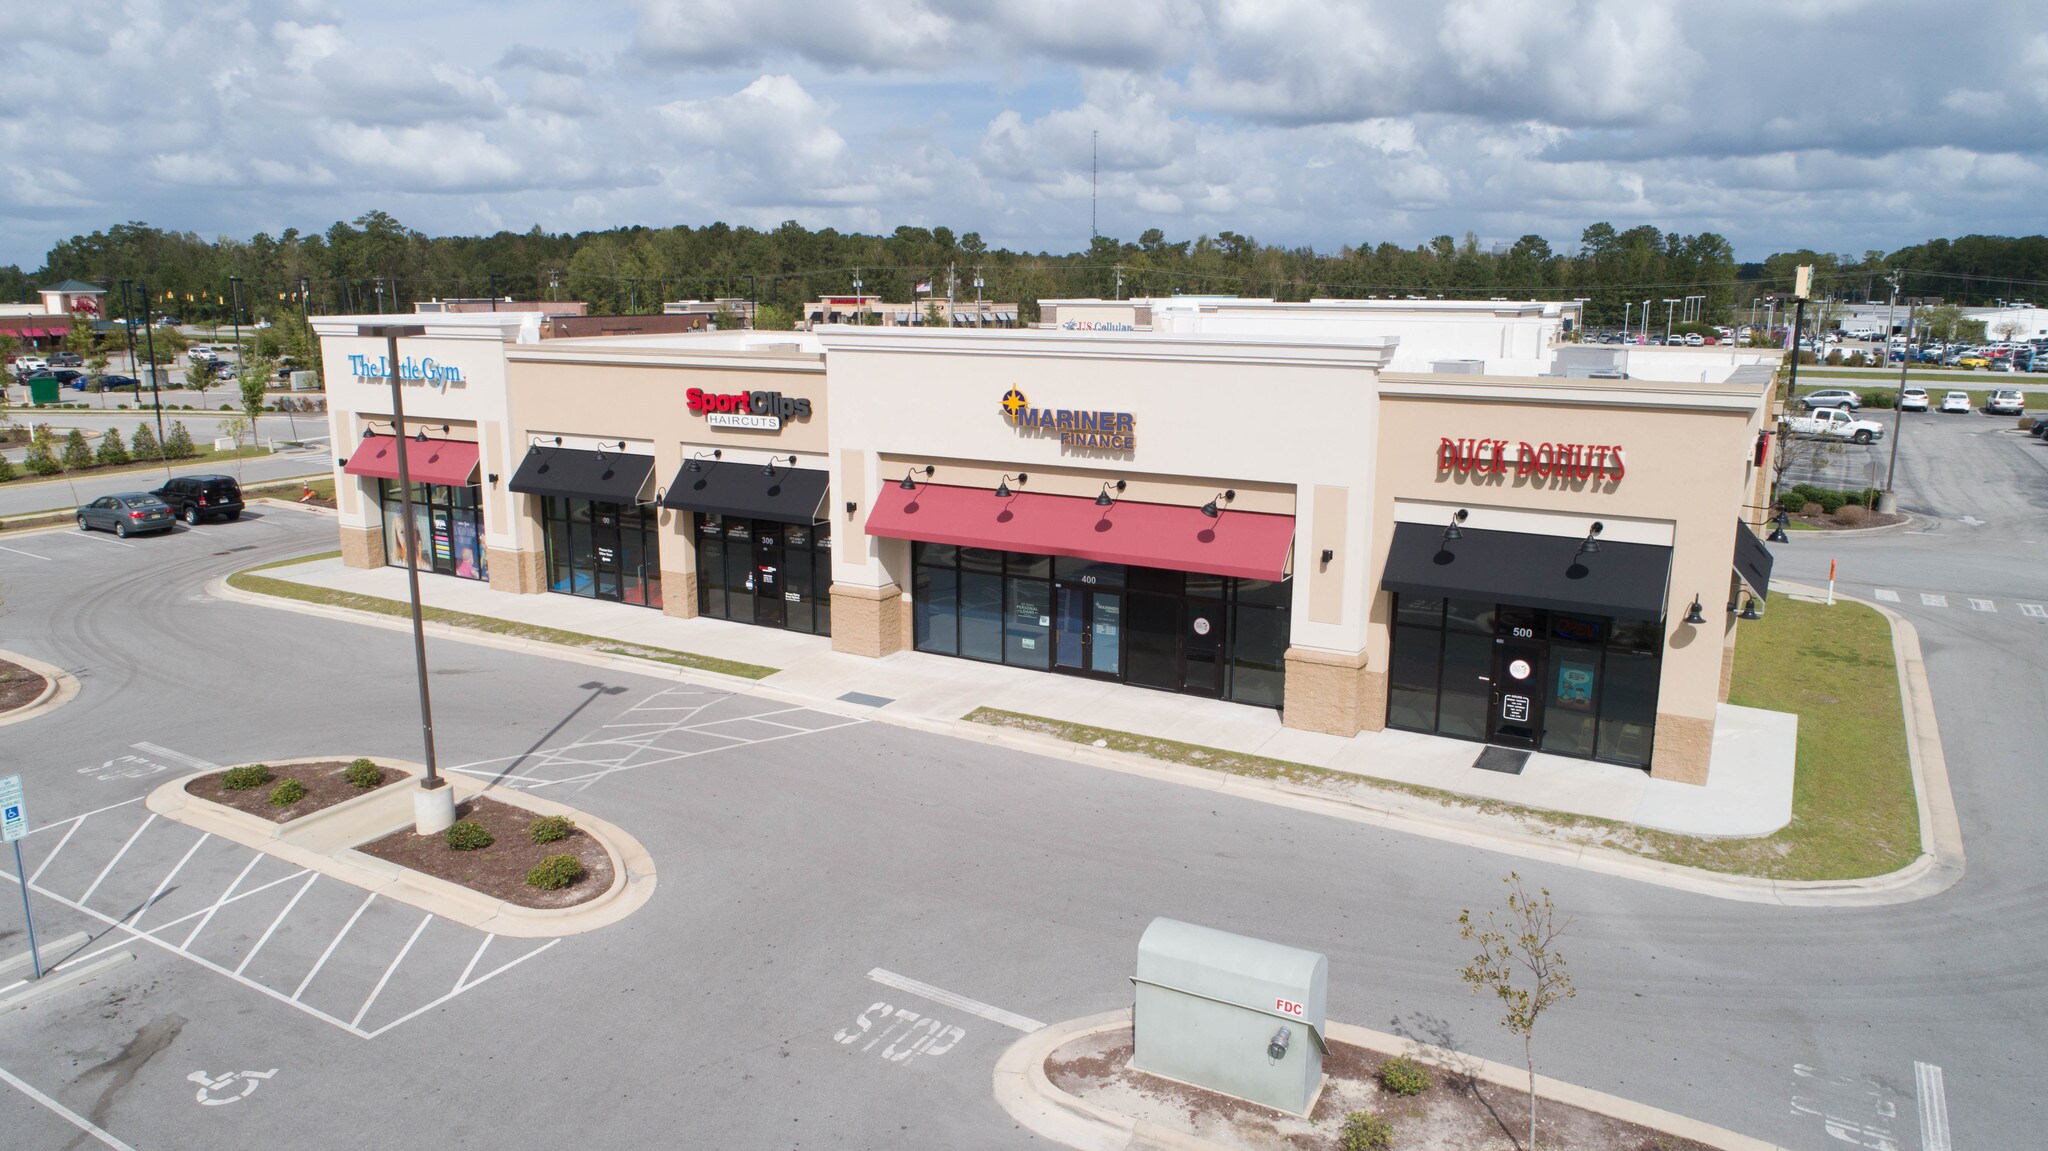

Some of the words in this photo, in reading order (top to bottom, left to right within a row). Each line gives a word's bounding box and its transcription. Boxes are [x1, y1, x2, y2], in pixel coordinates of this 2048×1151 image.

[348, 354, 377, 377] The
[379, 356, 419, 379] Ltle
[422, 357, 461, 387] Gym
[709, 415, 777, 428] HAIRCUTS
[1018, 407, 1135, 432] MARINER
[1061, 432, 1135, 450] FINANCE
[1439, 437, 1509, 474] DUCK
[1517, 441, 1625, 481] DONUTS
[762, 536, 774, 545] 300
[1082, 575, 1096, 584] 400
[1513, 627, 1533, 638] 500
[1276, 999, 1302, 1015] FDC
[833, 1002, 965, 1066] STOP
